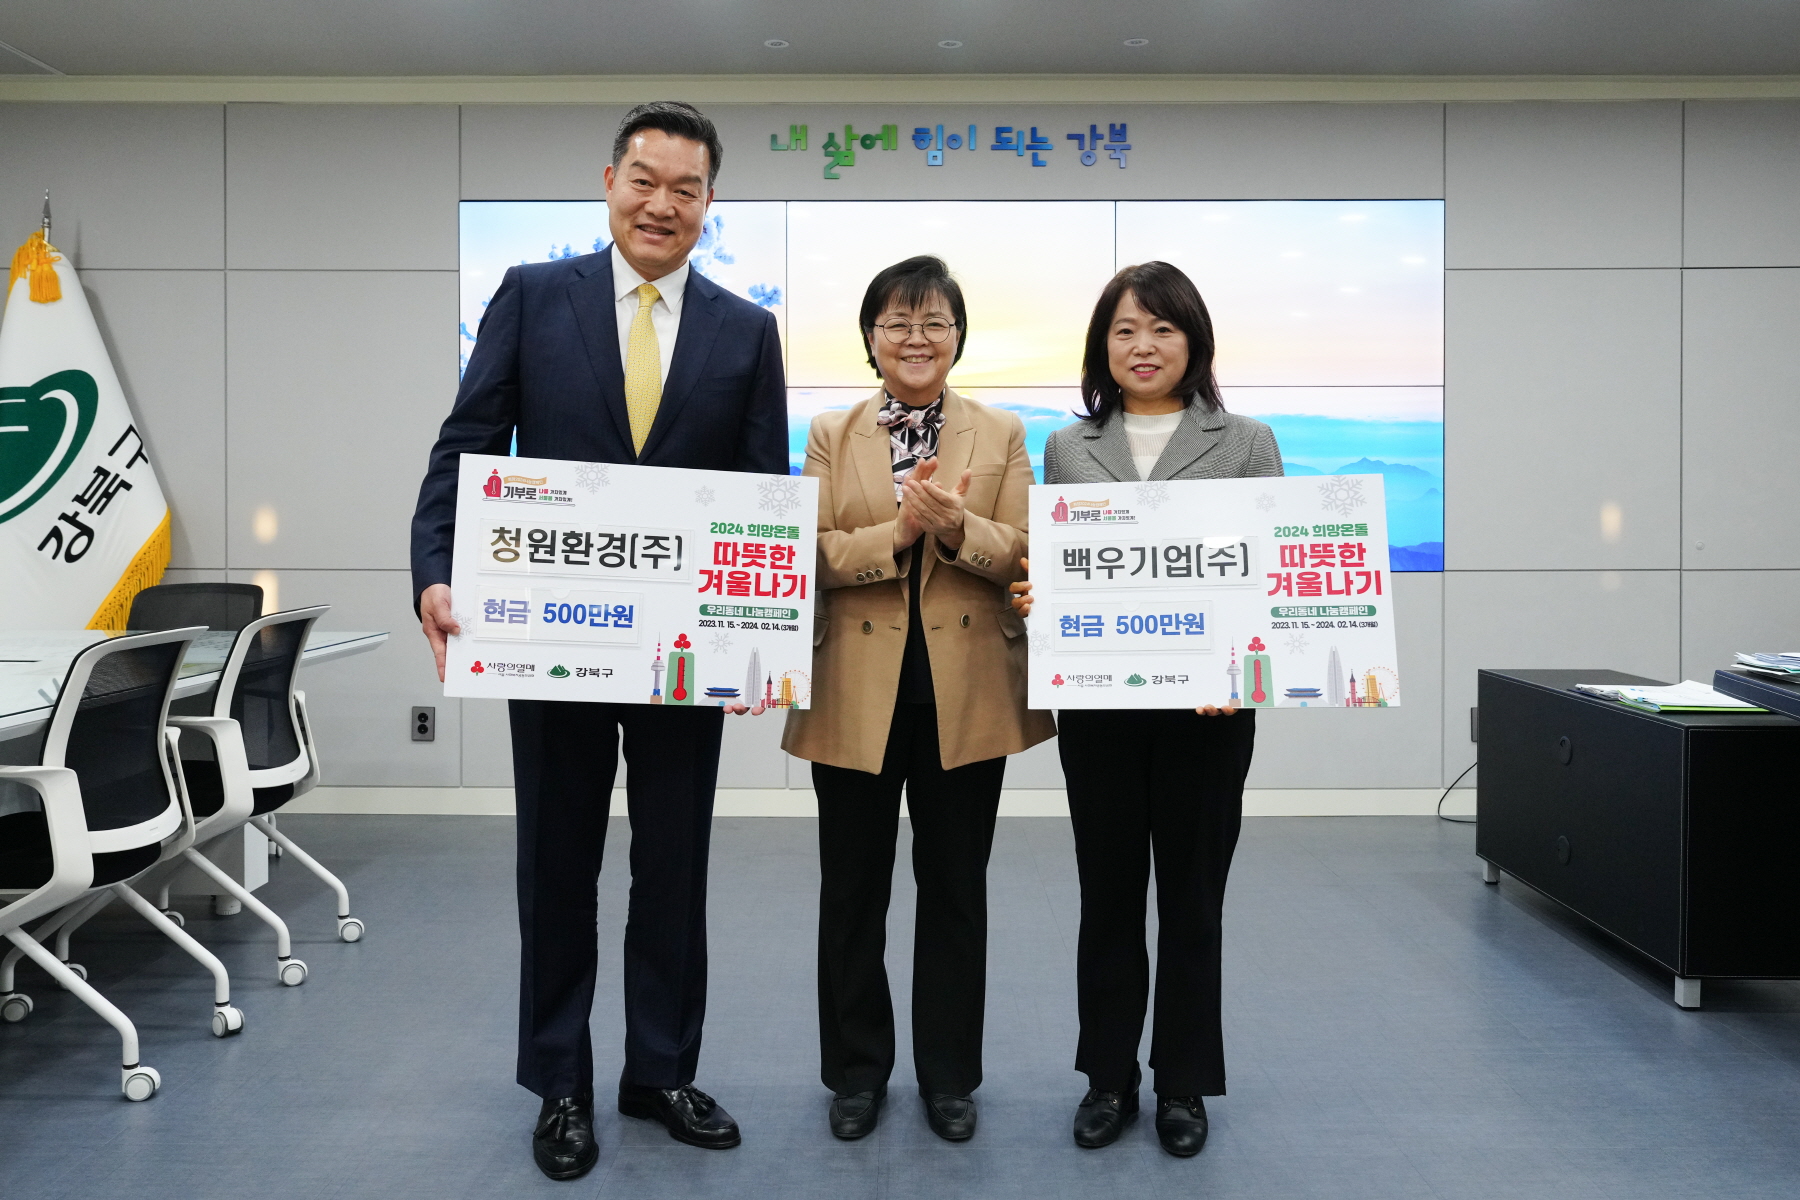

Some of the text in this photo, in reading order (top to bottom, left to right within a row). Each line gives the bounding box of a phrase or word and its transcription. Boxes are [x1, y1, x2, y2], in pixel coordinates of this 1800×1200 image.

[770, 123, 1132, 180] 내 삶에 힘이 되는 강북
[37, 423, 149, 563] 강북구
[503, 486, 537, 500] 기부로
[1070, 510, 1101, 521] 기부로
[710, 522, 800, 539] 2024 희망온돌
[1274, 523, 1368, 538] 2024 희망온돌
[490, 526, 683, 572] 청원환경(주)
[713, 541, 796, 570] 따뜻한
[1279, 542, 1366, 568] 따뜻한
[1063, 542, 1249, 580] 백우기업(주)
[698, 569, 807, 600] 겨울나기
[1267, 570, 1382, 597] 겨울나기
[483, 598, 634, 628] 현금 500만원
[706, 605, 791, 618] 우리동네 나눔캠페인
[1278, 605, 1368, 616] 우리동네 나눔캠페인
[1059, 612, 1205, 637] 현금 500만원
[487, 663, 535, 673] 사랑의열매
[575, 667, 614, 678] 강북구
[1066, 674, 1113, 684] 사랑의열매
[1151, 674, 1189, 685] 강북구
